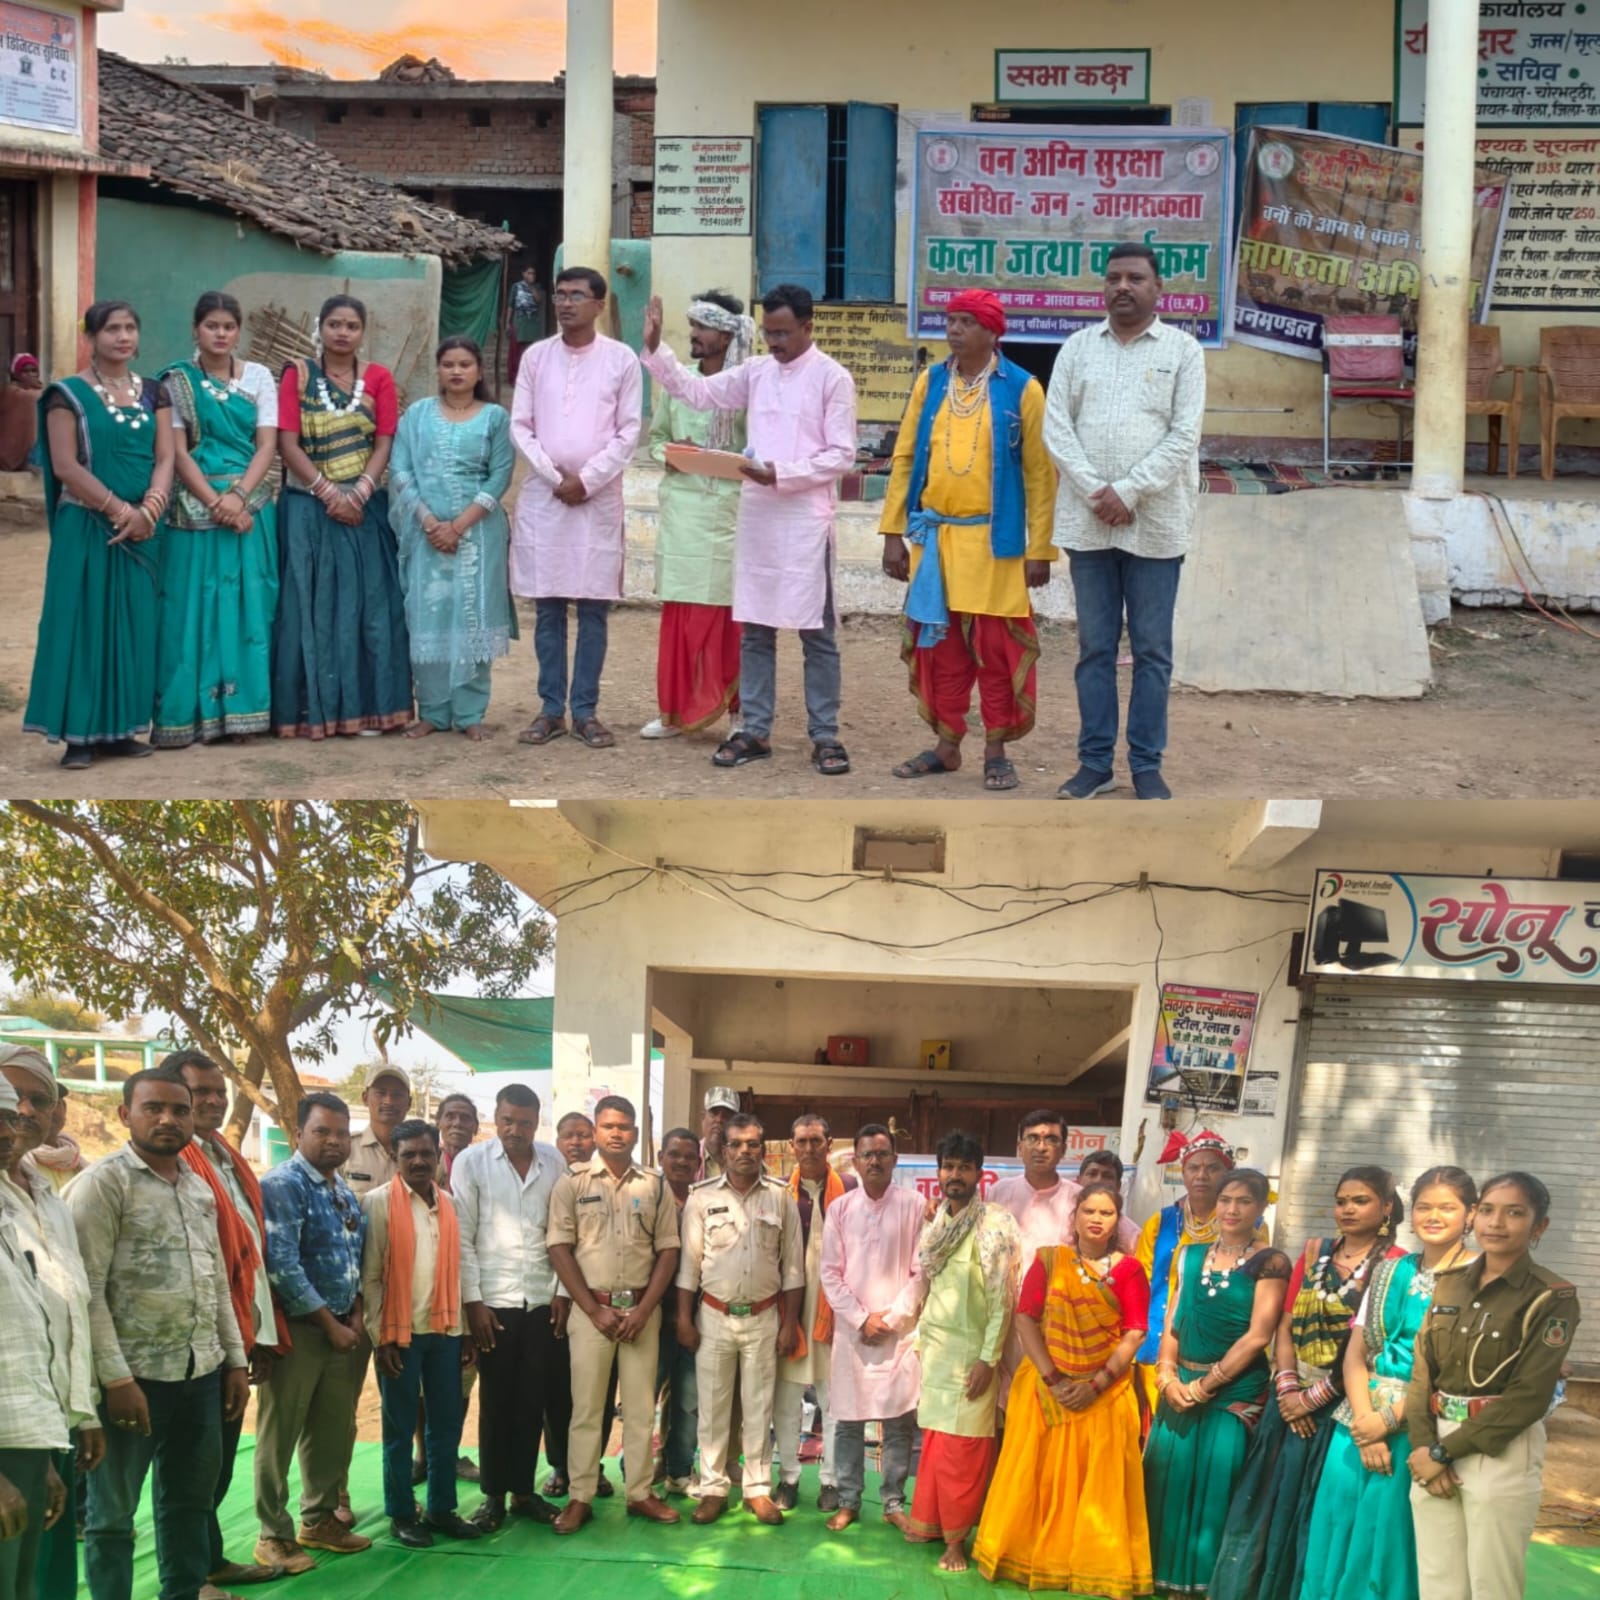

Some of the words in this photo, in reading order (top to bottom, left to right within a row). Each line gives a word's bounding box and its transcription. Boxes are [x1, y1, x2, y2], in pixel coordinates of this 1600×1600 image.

[1006, 64, 1070, 87] सभा
[1074, 64, 1133, 95] कक्ष
[1495, 57, 1561, 81] सचिव
[1533, 139, 1600, 159] सूचना
[979, 147, 1016, 177] वन
[1022, 140, 1089, 178] अग्नि
[1094, 147, 1165, 188] सुरक्षा
[1565, 161, 1595, 174] धारा
[1030, 191, 1070, 217] जन
[1556, 207, 1573, 221] पर
[1574, 207, 1596, 219] 250
[1264, 204, 1290, 225] वनों
[1294, 209, 1313, 230] को
[1316, 216, 1349, 237] आग
[1353, 221, 1367, 242] से
[927, 237, 997, 275] कला
[1005, 239, 1084, 277] जत्था
[1525, 268, 1539, 279] 20
[1014, 294, 1034, 305] नाम
[1344, 879, 1371, 890] Digital
[1373, 880, 1393, 890] India
[1420, 883, 1598, 974] सोनू
